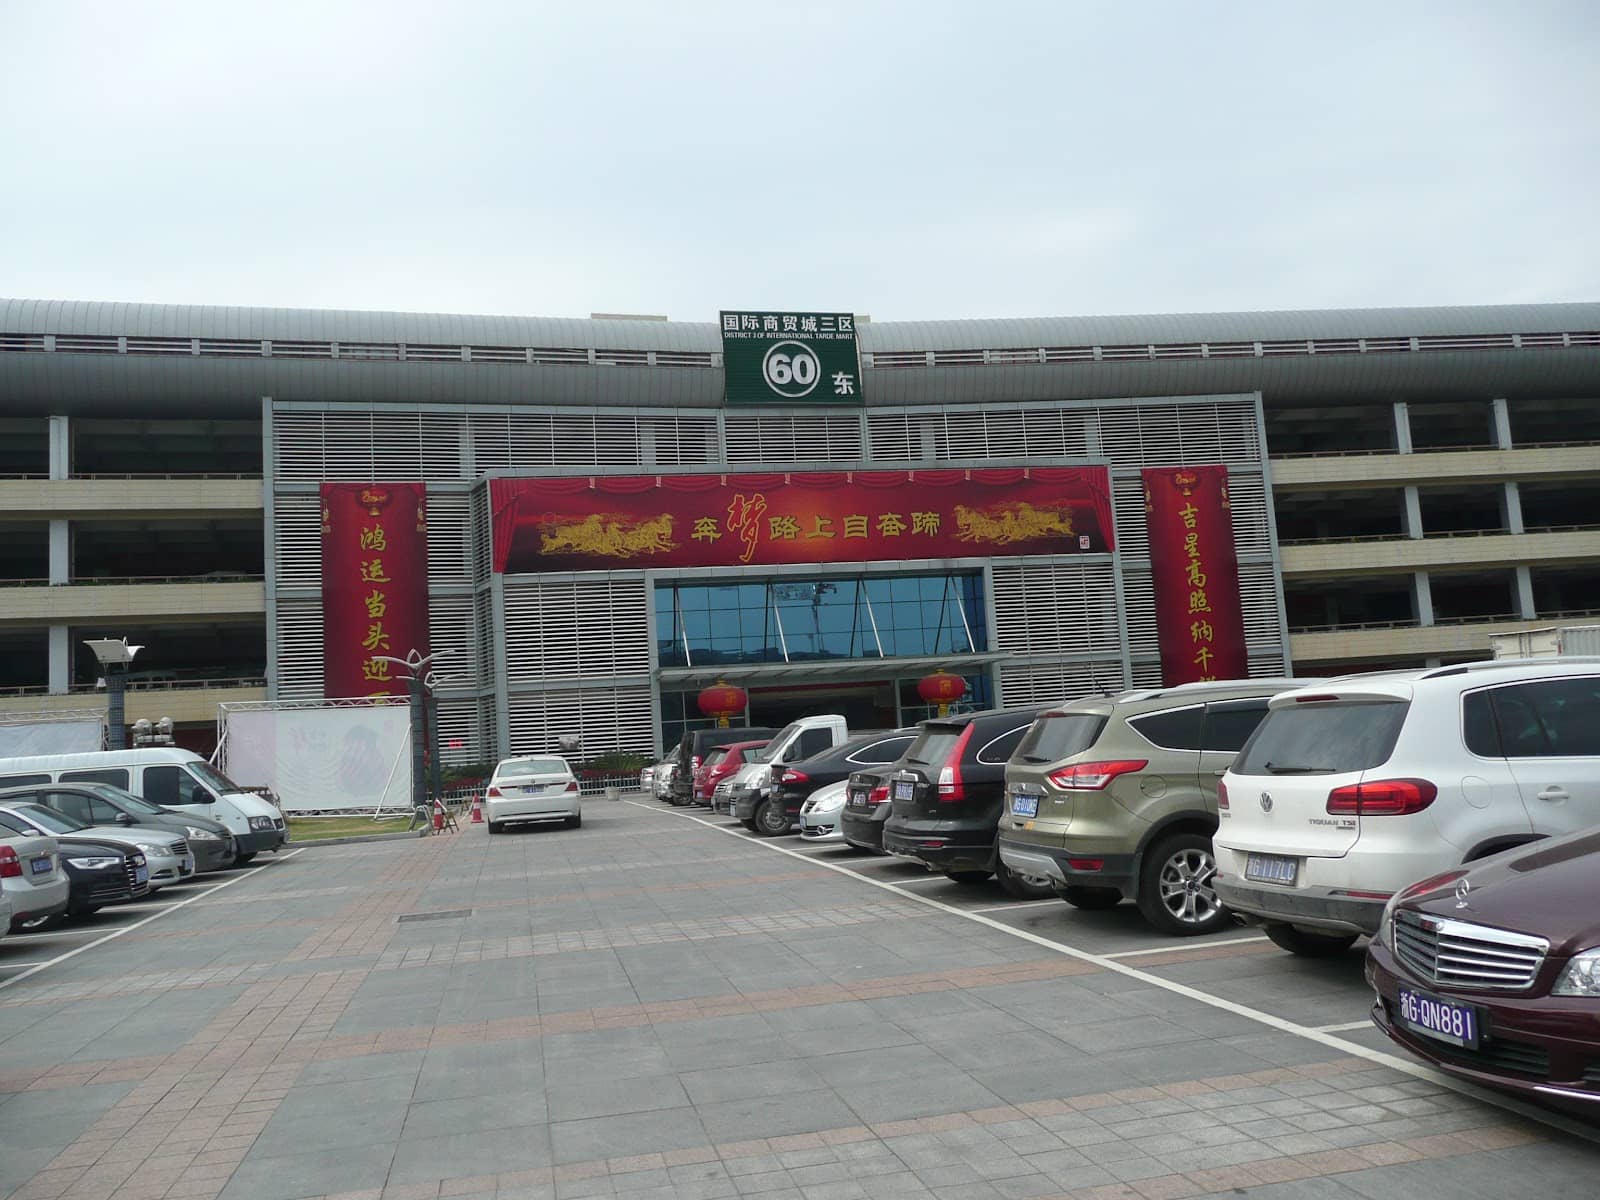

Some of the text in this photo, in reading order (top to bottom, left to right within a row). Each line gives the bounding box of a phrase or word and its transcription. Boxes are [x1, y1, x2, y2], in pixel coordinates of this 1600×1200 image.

[723, 314, 853, 331] 国际商贸城三区
[724, 331, 752, 339] DISTRICT
[768, 353, 816, 385] 60
[831, 371, 854, 395] 东
[1178, 502, 1217, 682] 吉星高照纳千
